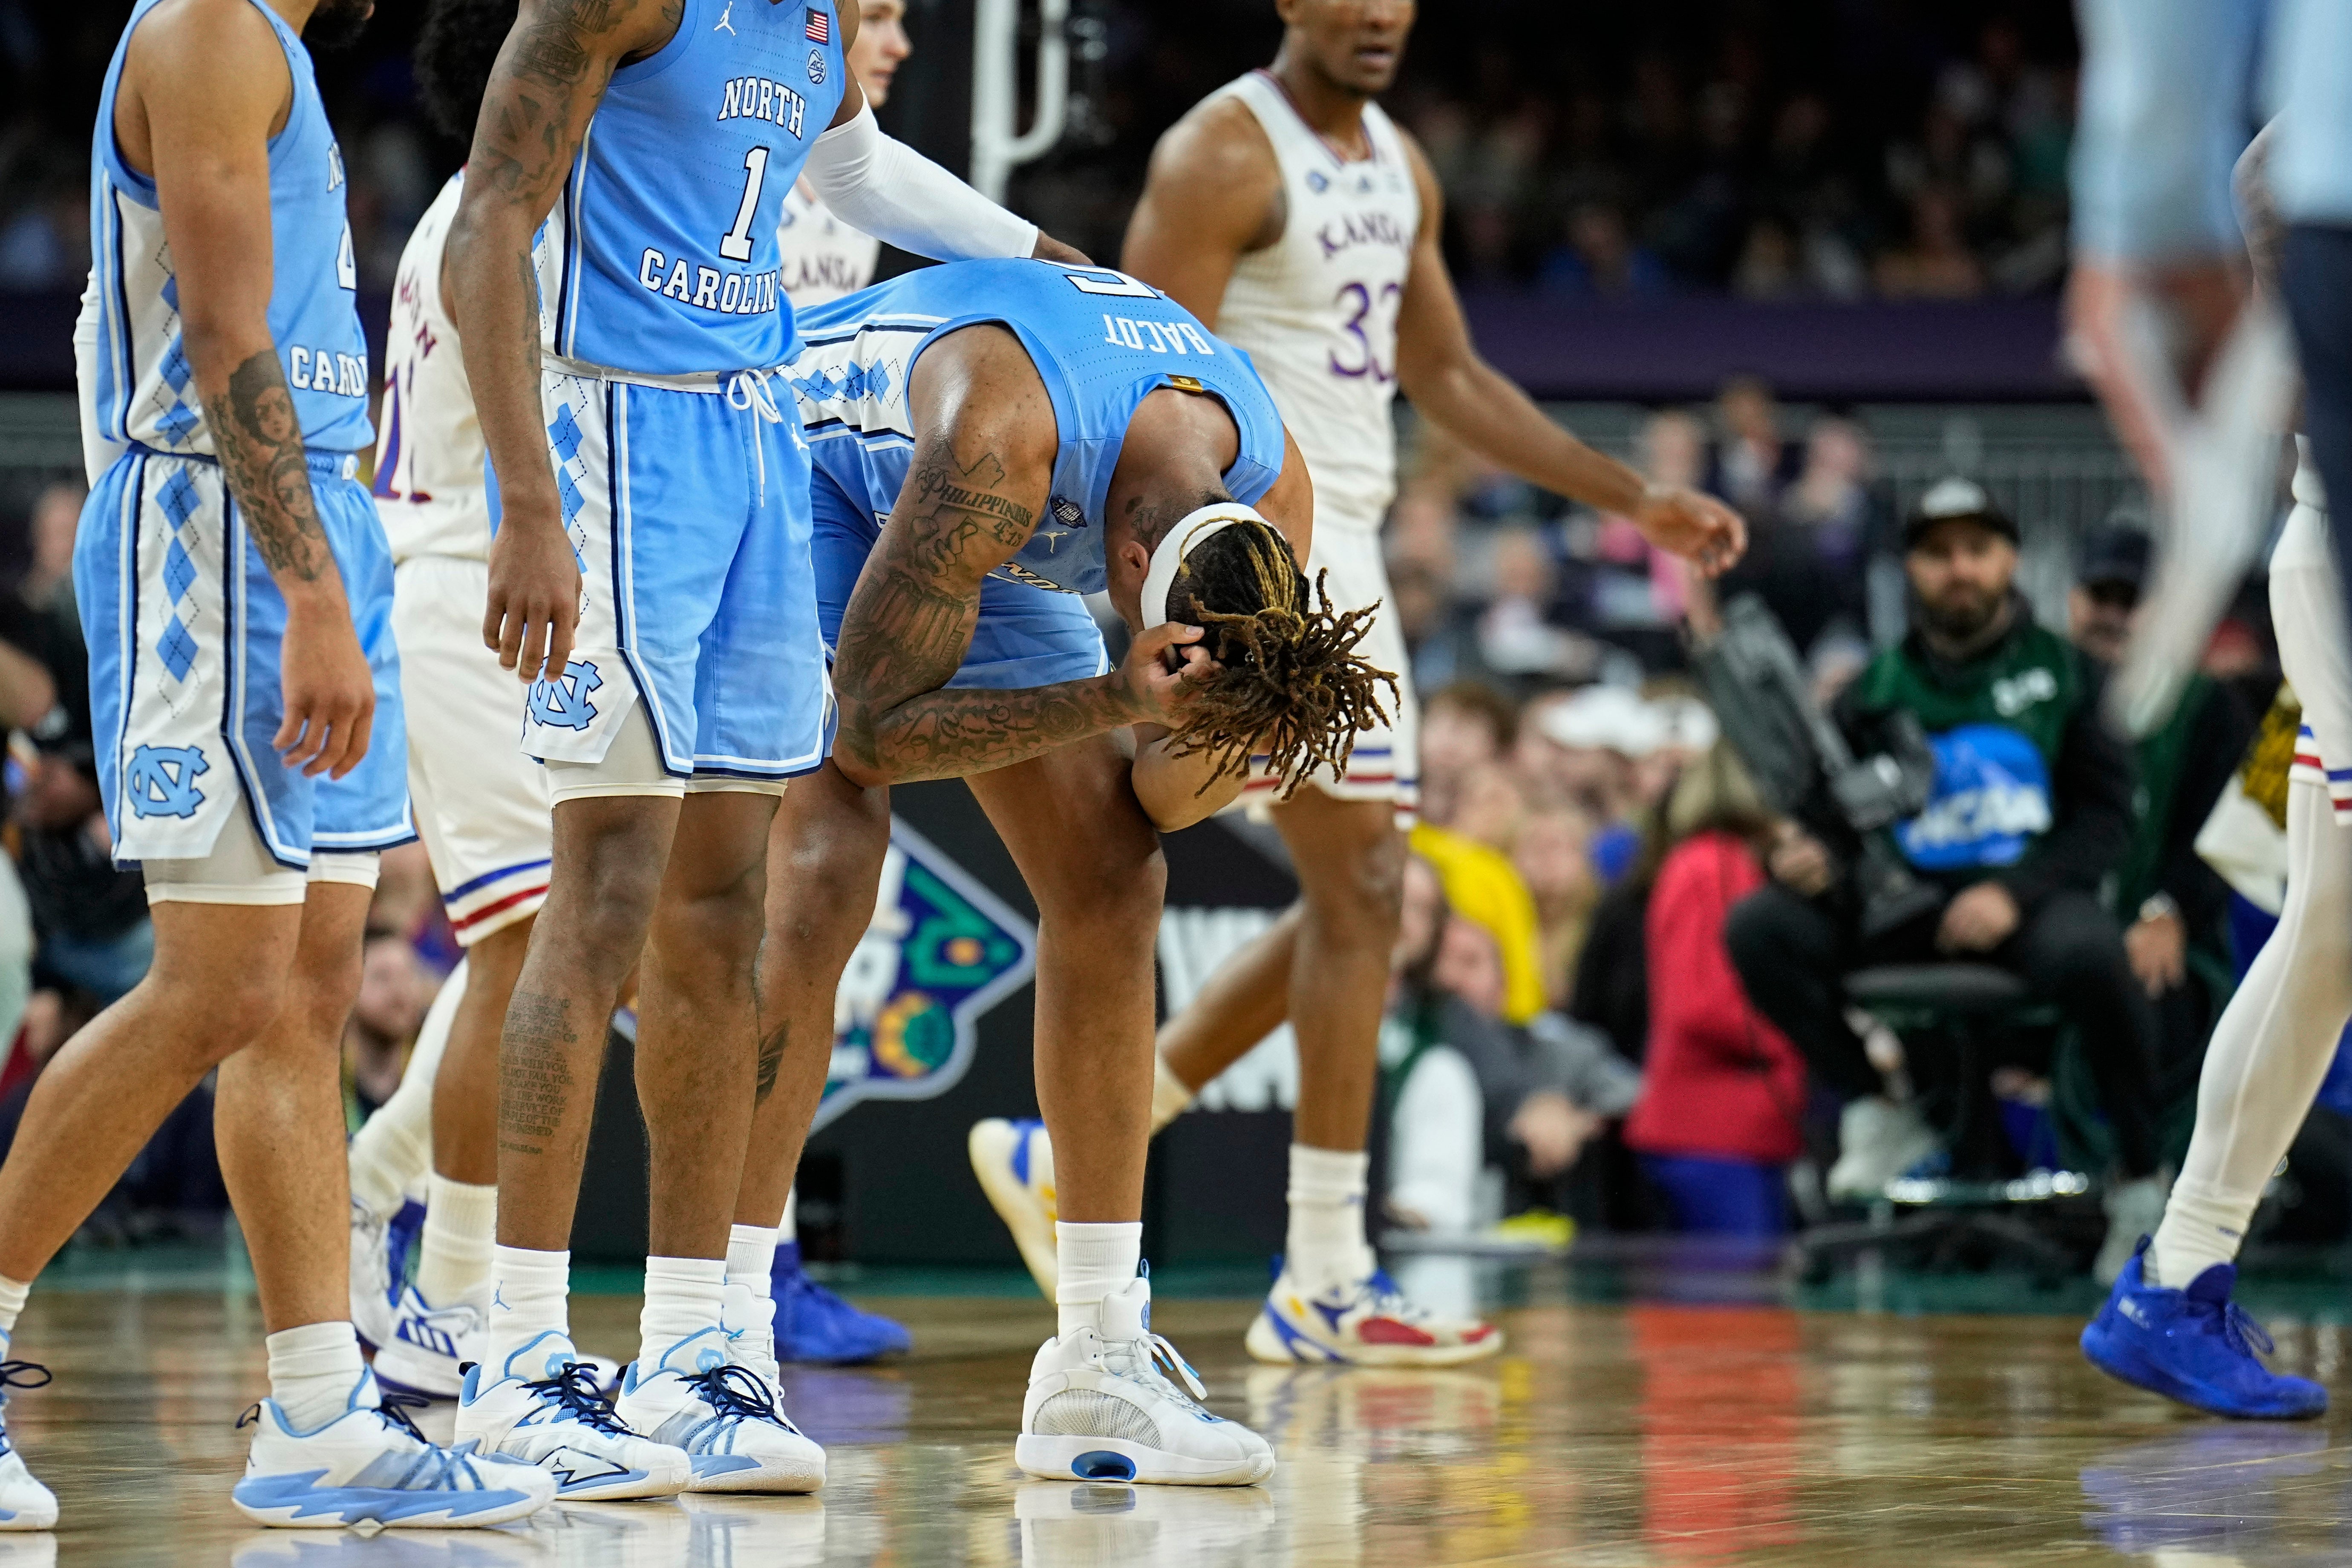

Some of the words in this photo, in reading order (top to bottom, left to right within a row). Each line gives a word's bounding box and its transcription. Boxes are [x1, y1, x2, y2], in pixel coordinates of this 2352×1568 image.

[717, 77, 806, 141] NORTH
[719, 146, 770, 263] 1
[639, 247, 783, 314] CAROLIN
[1102, 314, 1215, 355] BACOT
[1056, 508, 1077, 521] FOUR
[1061, 504, 1081, 518] FINAL
